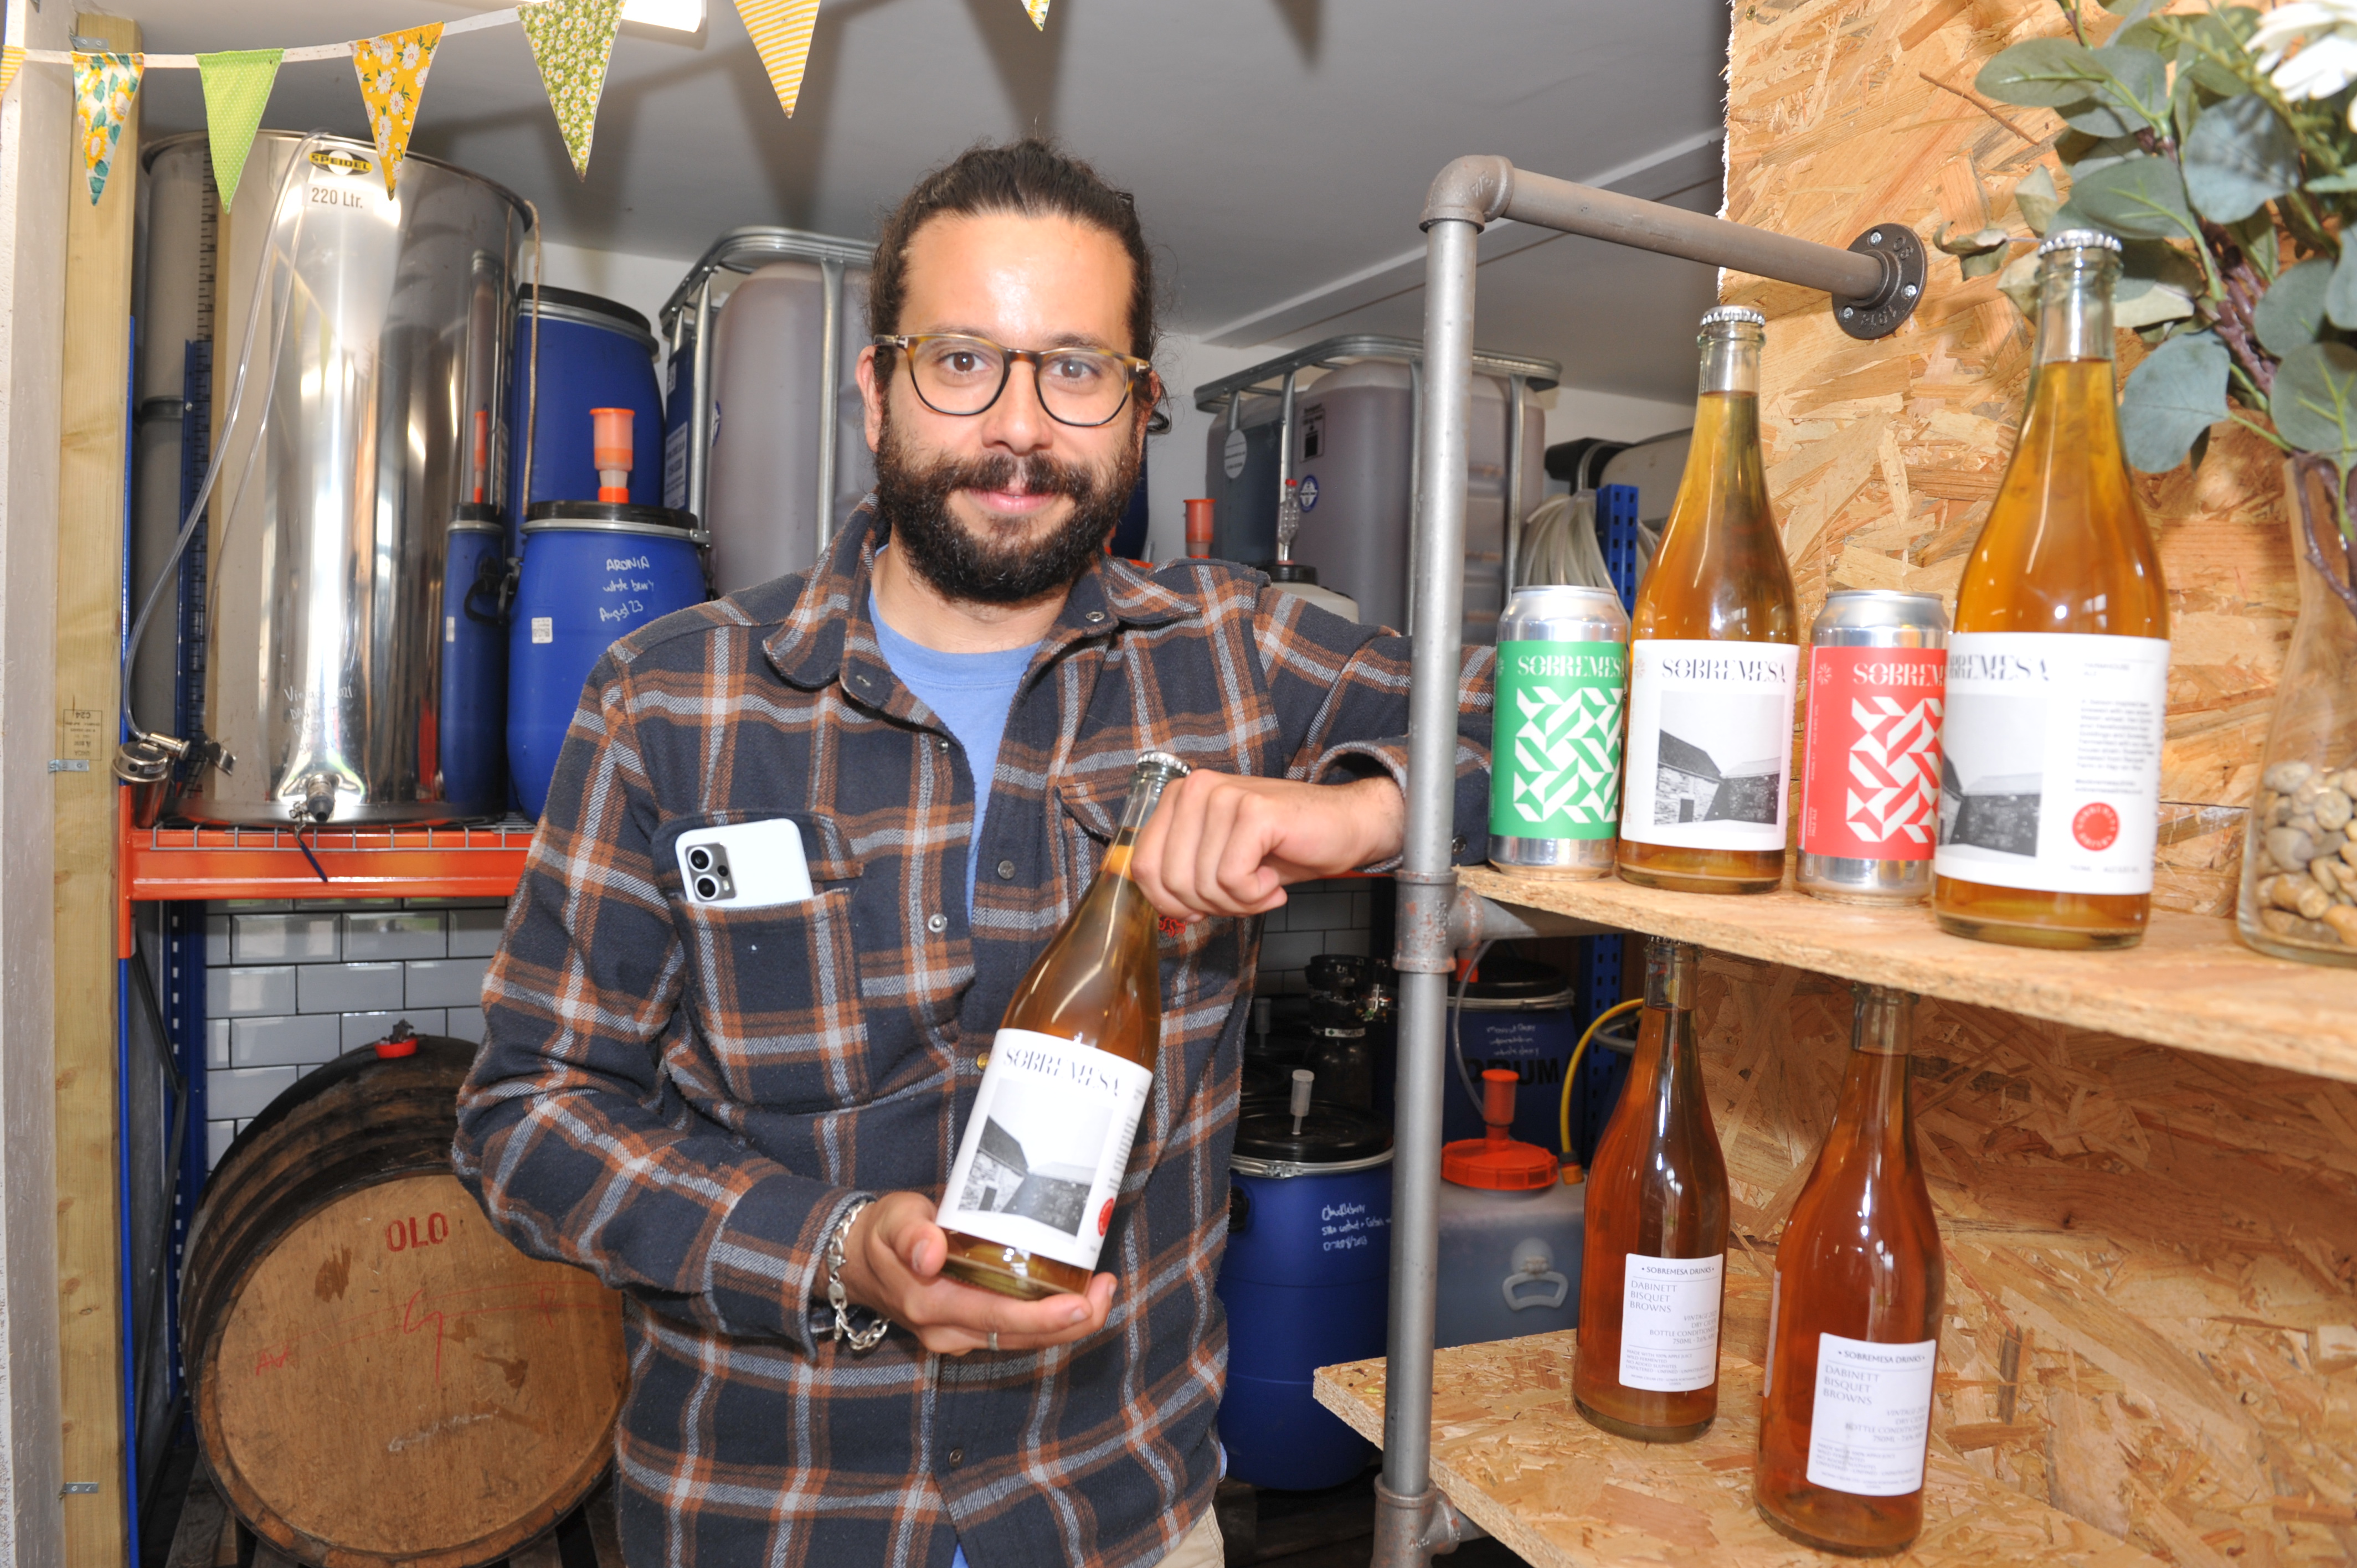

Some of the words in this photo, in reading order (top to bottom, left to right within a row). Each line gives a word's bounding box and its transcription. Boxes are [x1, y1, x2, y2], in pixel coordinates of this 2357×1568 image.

[311, 154, 369, 171] SPEIDEL
[311, 187, 338, 205] 220
[343, 191, 363, 209] Ltr.
[606, 555, 650, 571] ARONIA
[628, 600, 644, 613] 23
[1662, 658, 1786, 683] SOBREMESA
[1853, 662, 1945, 687] SOBREM
[1003, 1046, 1118, 1097] SOBREMESA
[386, 1211, 449, 1253] OLO
[1646, 1266, 1689, 1275] SOBREMESA
[1690, 1266, 1712, 1275] DRINKS
[1631, 1280, 1677, 1292] DABINETT
[1630, 1291, 1670, 1302] BISQUET
[1630, 1301, 1671, 1313] BROWNS
[1684, 1313, 1708, 1321] VINTAGE
[1844, 1350, 1894, 1363] SOBREMESA
[1895, 1355, 1922, 1364] DRINKS
[1825, 1365, 1880, 1383] DABINETT
[1824, 1376, 1871, 1393] BISQUET
[1823, 1388, 1872, 1405] BROWNS
